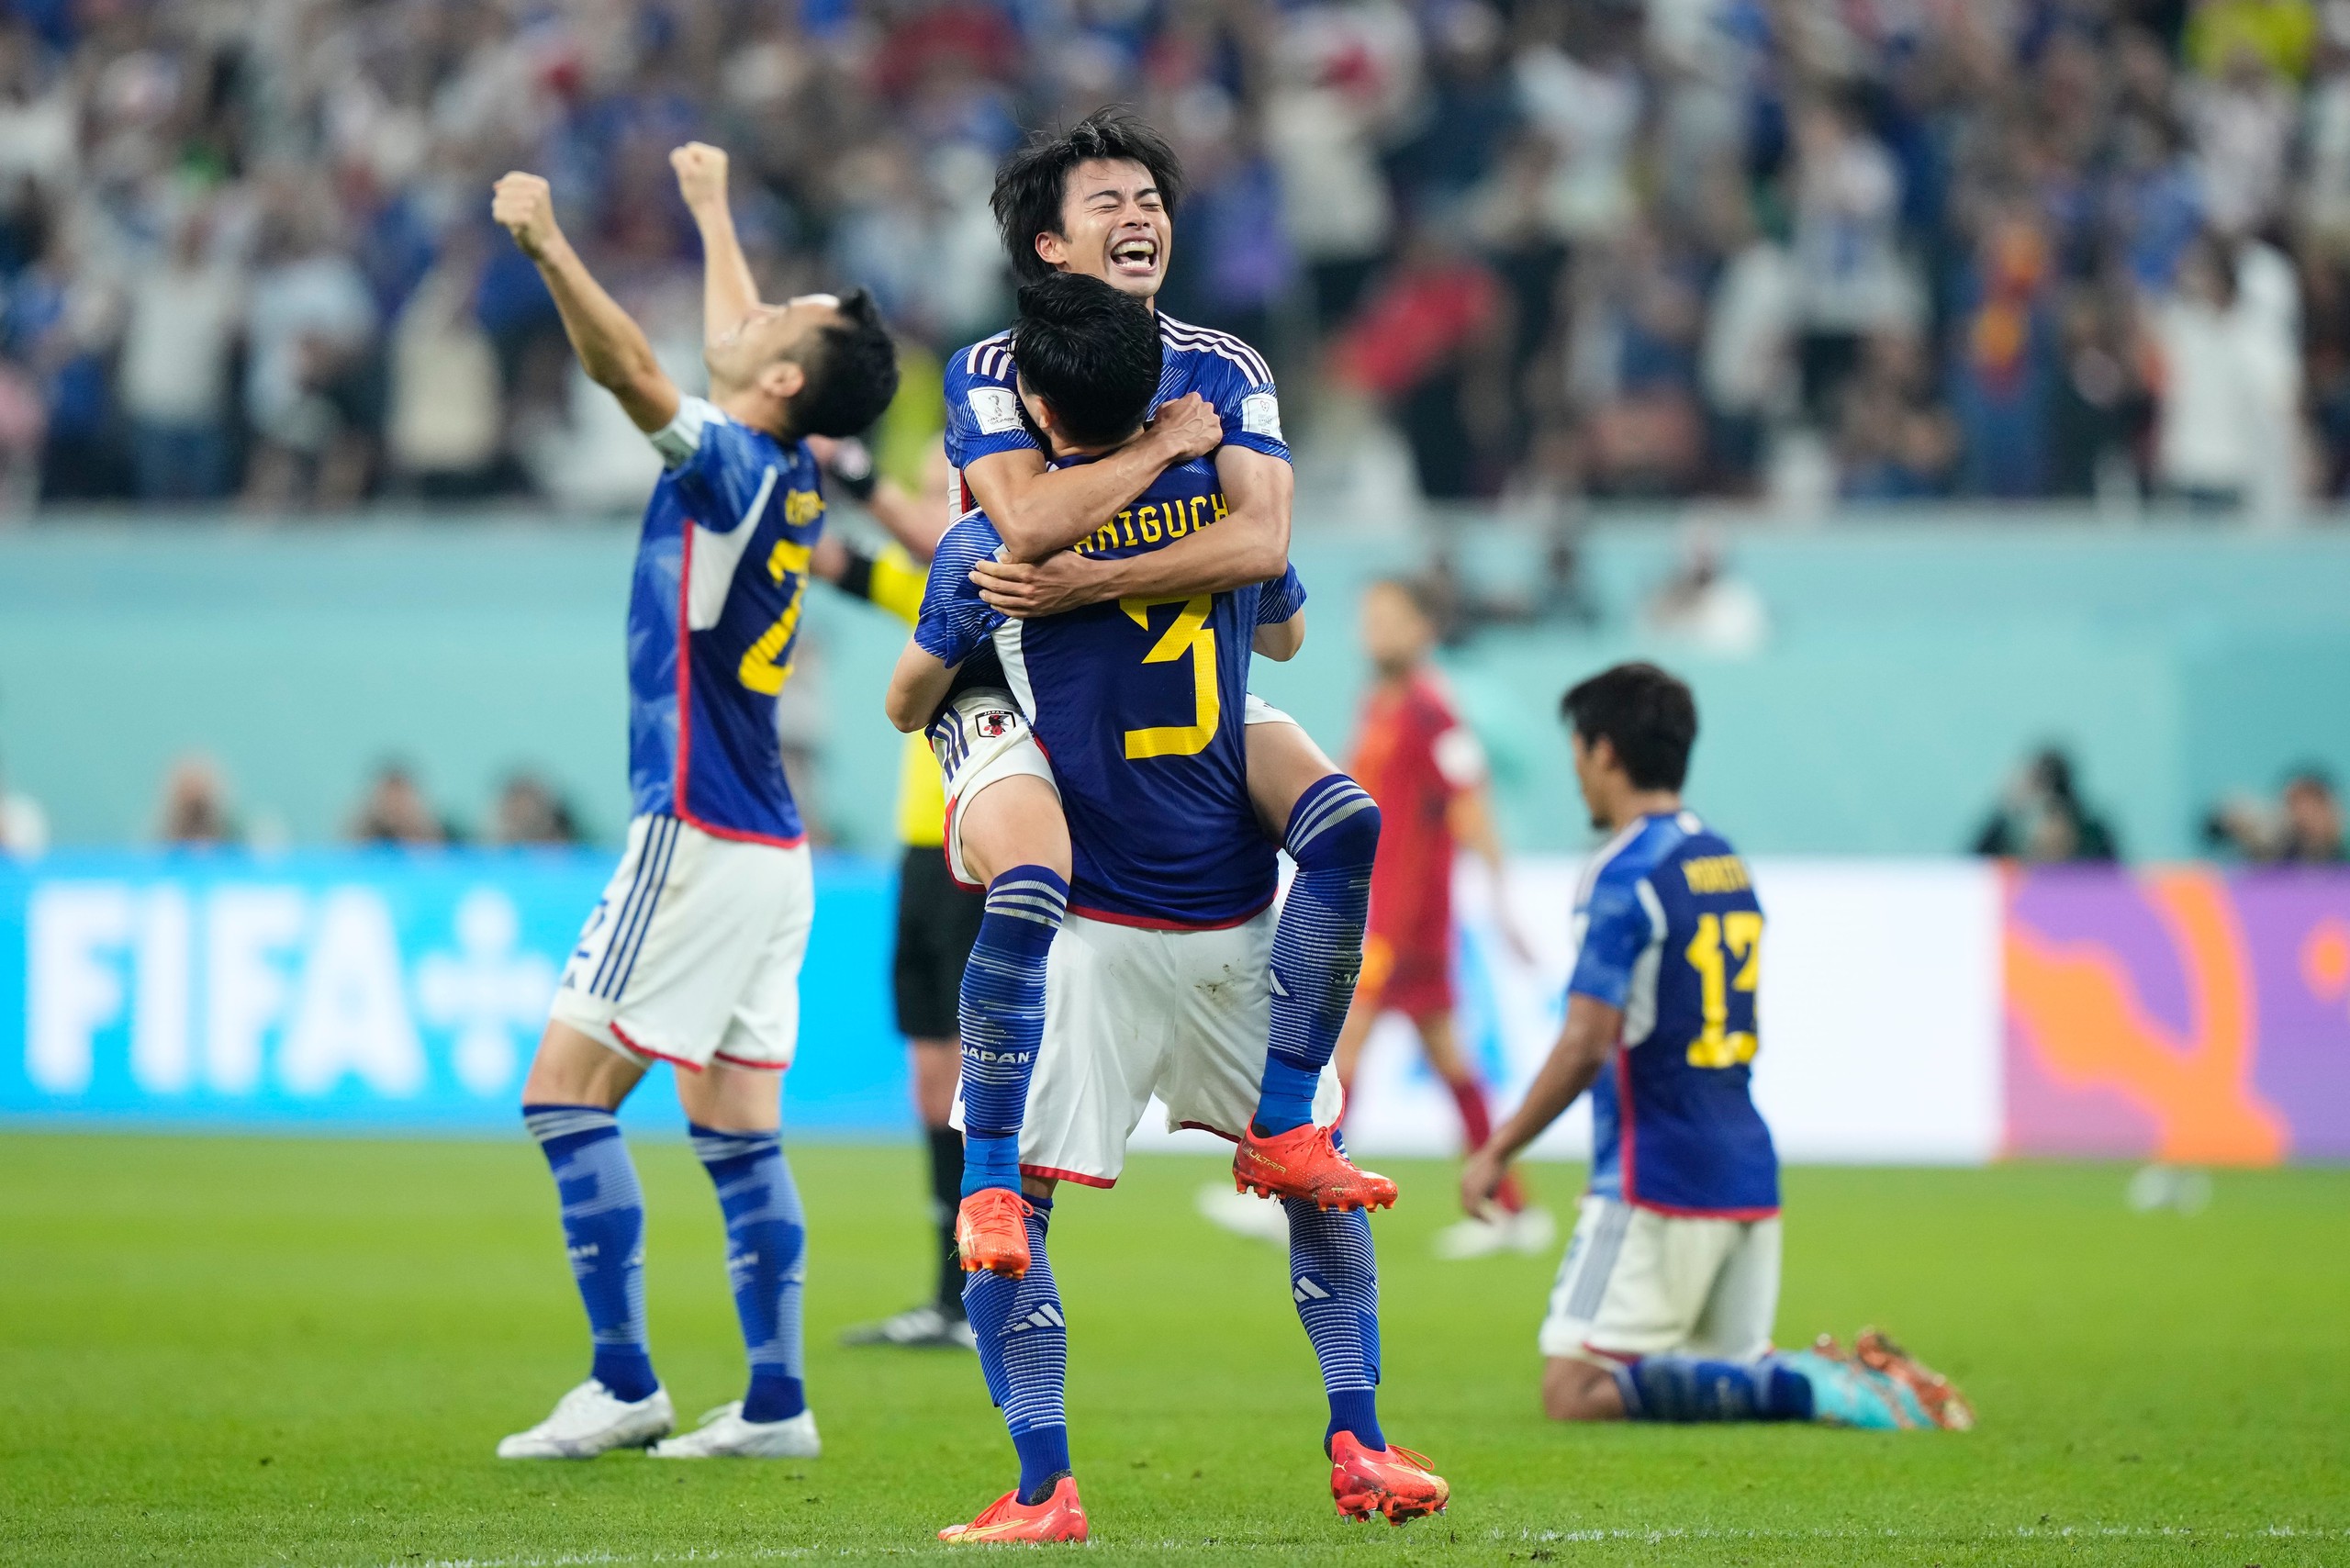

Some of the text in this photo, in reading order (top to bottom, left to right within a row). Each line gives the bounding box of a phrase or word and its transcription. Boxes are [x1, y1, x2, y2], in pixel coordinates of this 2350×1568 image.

[1073, 494, 1229, 554] ANIGUCH
[1119, 592, 1220, 759] 3
[961, 1044, 1030, 1064] JAPAN
[1249, 1148, 1287, 1174] ULTRA
